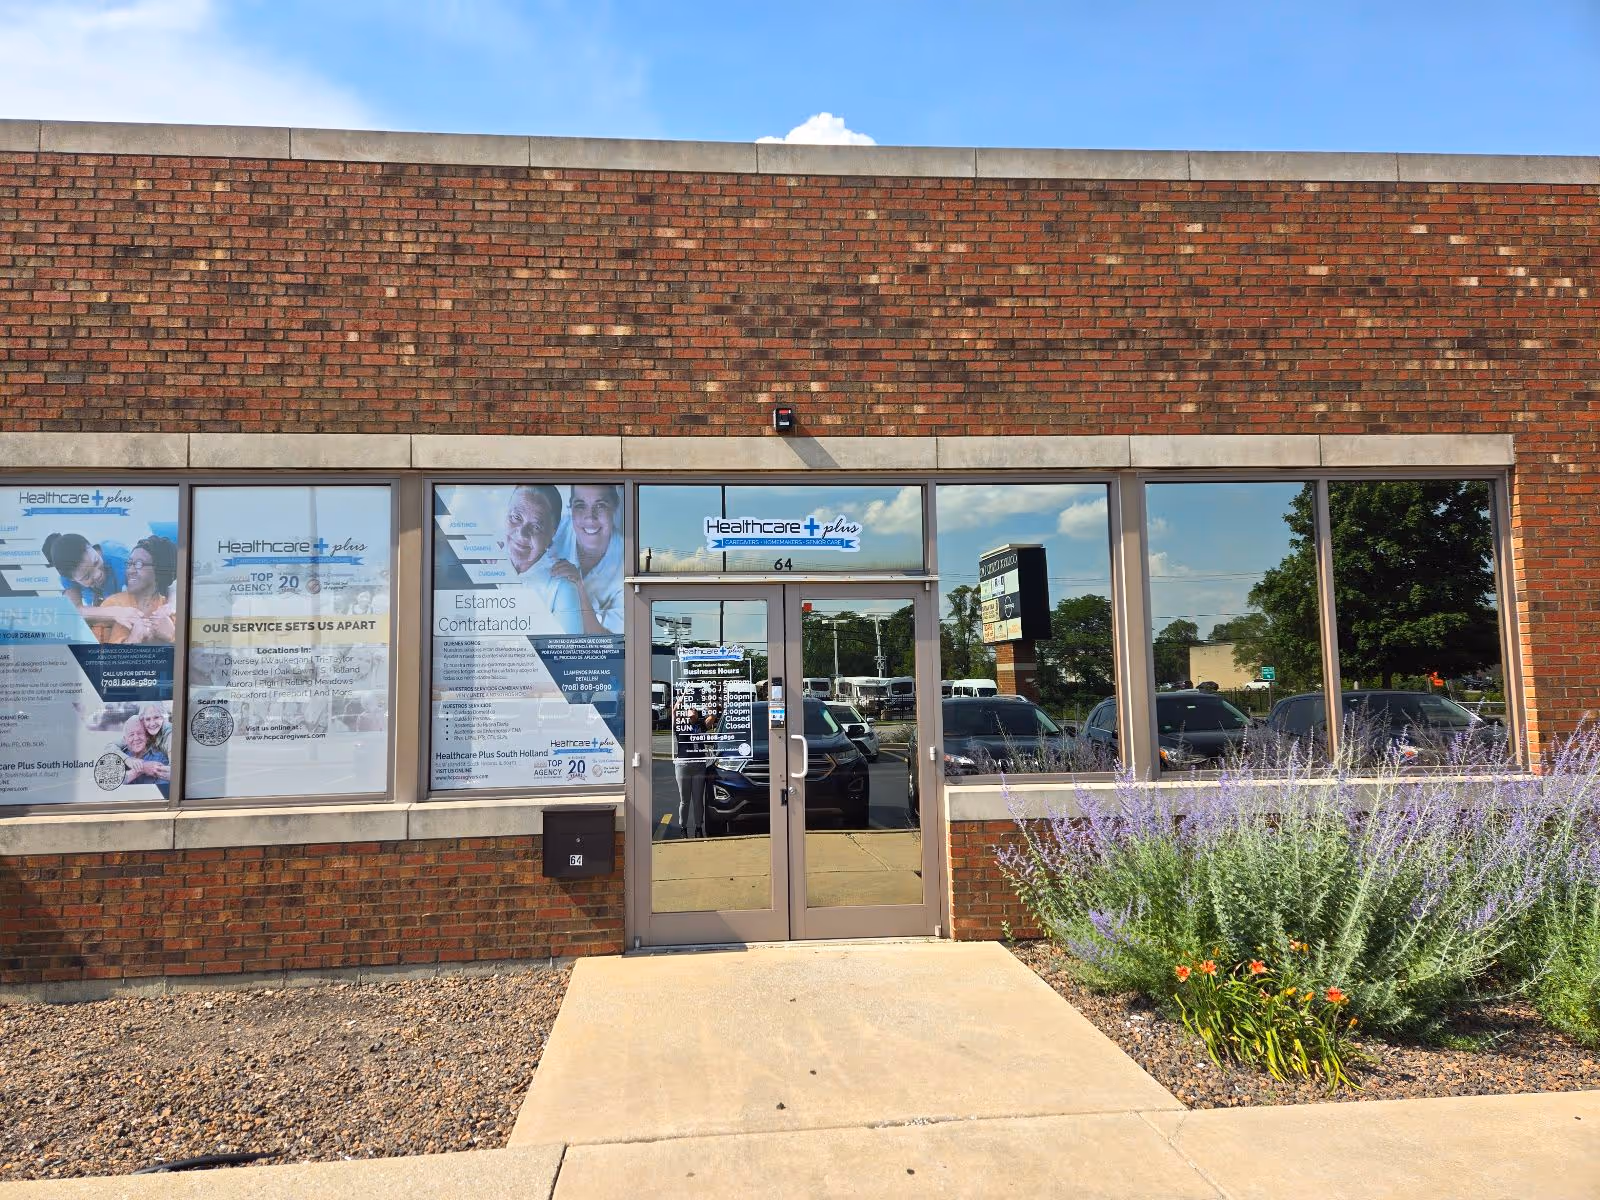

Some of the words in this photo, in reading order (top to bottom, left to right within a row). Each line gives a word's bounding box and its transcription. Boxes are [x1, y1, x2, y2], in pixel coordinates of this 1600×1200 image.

[19, 491, 89, 504] Healthcare
[104, 490, 133, 508] plus
[707, 520, 801, 534] Healthcare
[822, 518, 859, 539] plus
[218, 540, 310, 553] Healthcare
[330, 538, 368, 557] plus
[774, 558, 793, 571] 64
[251, 573, 274, 582] TOP
[230, 584, 273, 592] AGENCY
[279, 576, 300, 590] 20
[456, 595, 516, 609] Estamos
[203, 624, 229, 633] OUR
[232, 622, 282, 632] SERVICE
[285, 622, 315, 631] SETS
[318, 622, 334, 630] US
[336, 620, 376, 630] APART
[439, 616, 531, 632] Contratando!
[256, 647, 298, 655] Locations
[300, 646, 311, 654] In:
[224, 658, 259, 667] Diversey
[266, 656, 308, 665] Waukegan
[232, 668, 269, 677] Riverside
[101, 679, 119, 687] (708)
[122, 678, 157, 687] 808-9890
[285, 679, 312, 687] Rolling
[562, 684, 579, 692] (708)
[580, 684, 612, 692] 808-9890
[230, 691, 267, 699] Rockford
[551, 740, 591, 748] Healthcare
[436, 752, 478, 760] Healthcare
[496, 750, 518, 758] South
[520, 749, 549, 758] Holland
[18, 762, 34, 770] Plus
[37, 761, 60, 769] South
[62, 760, 94, 769] Holland
[568, 760, 586, 774] 20
[570, 856, 582, 865] 64
